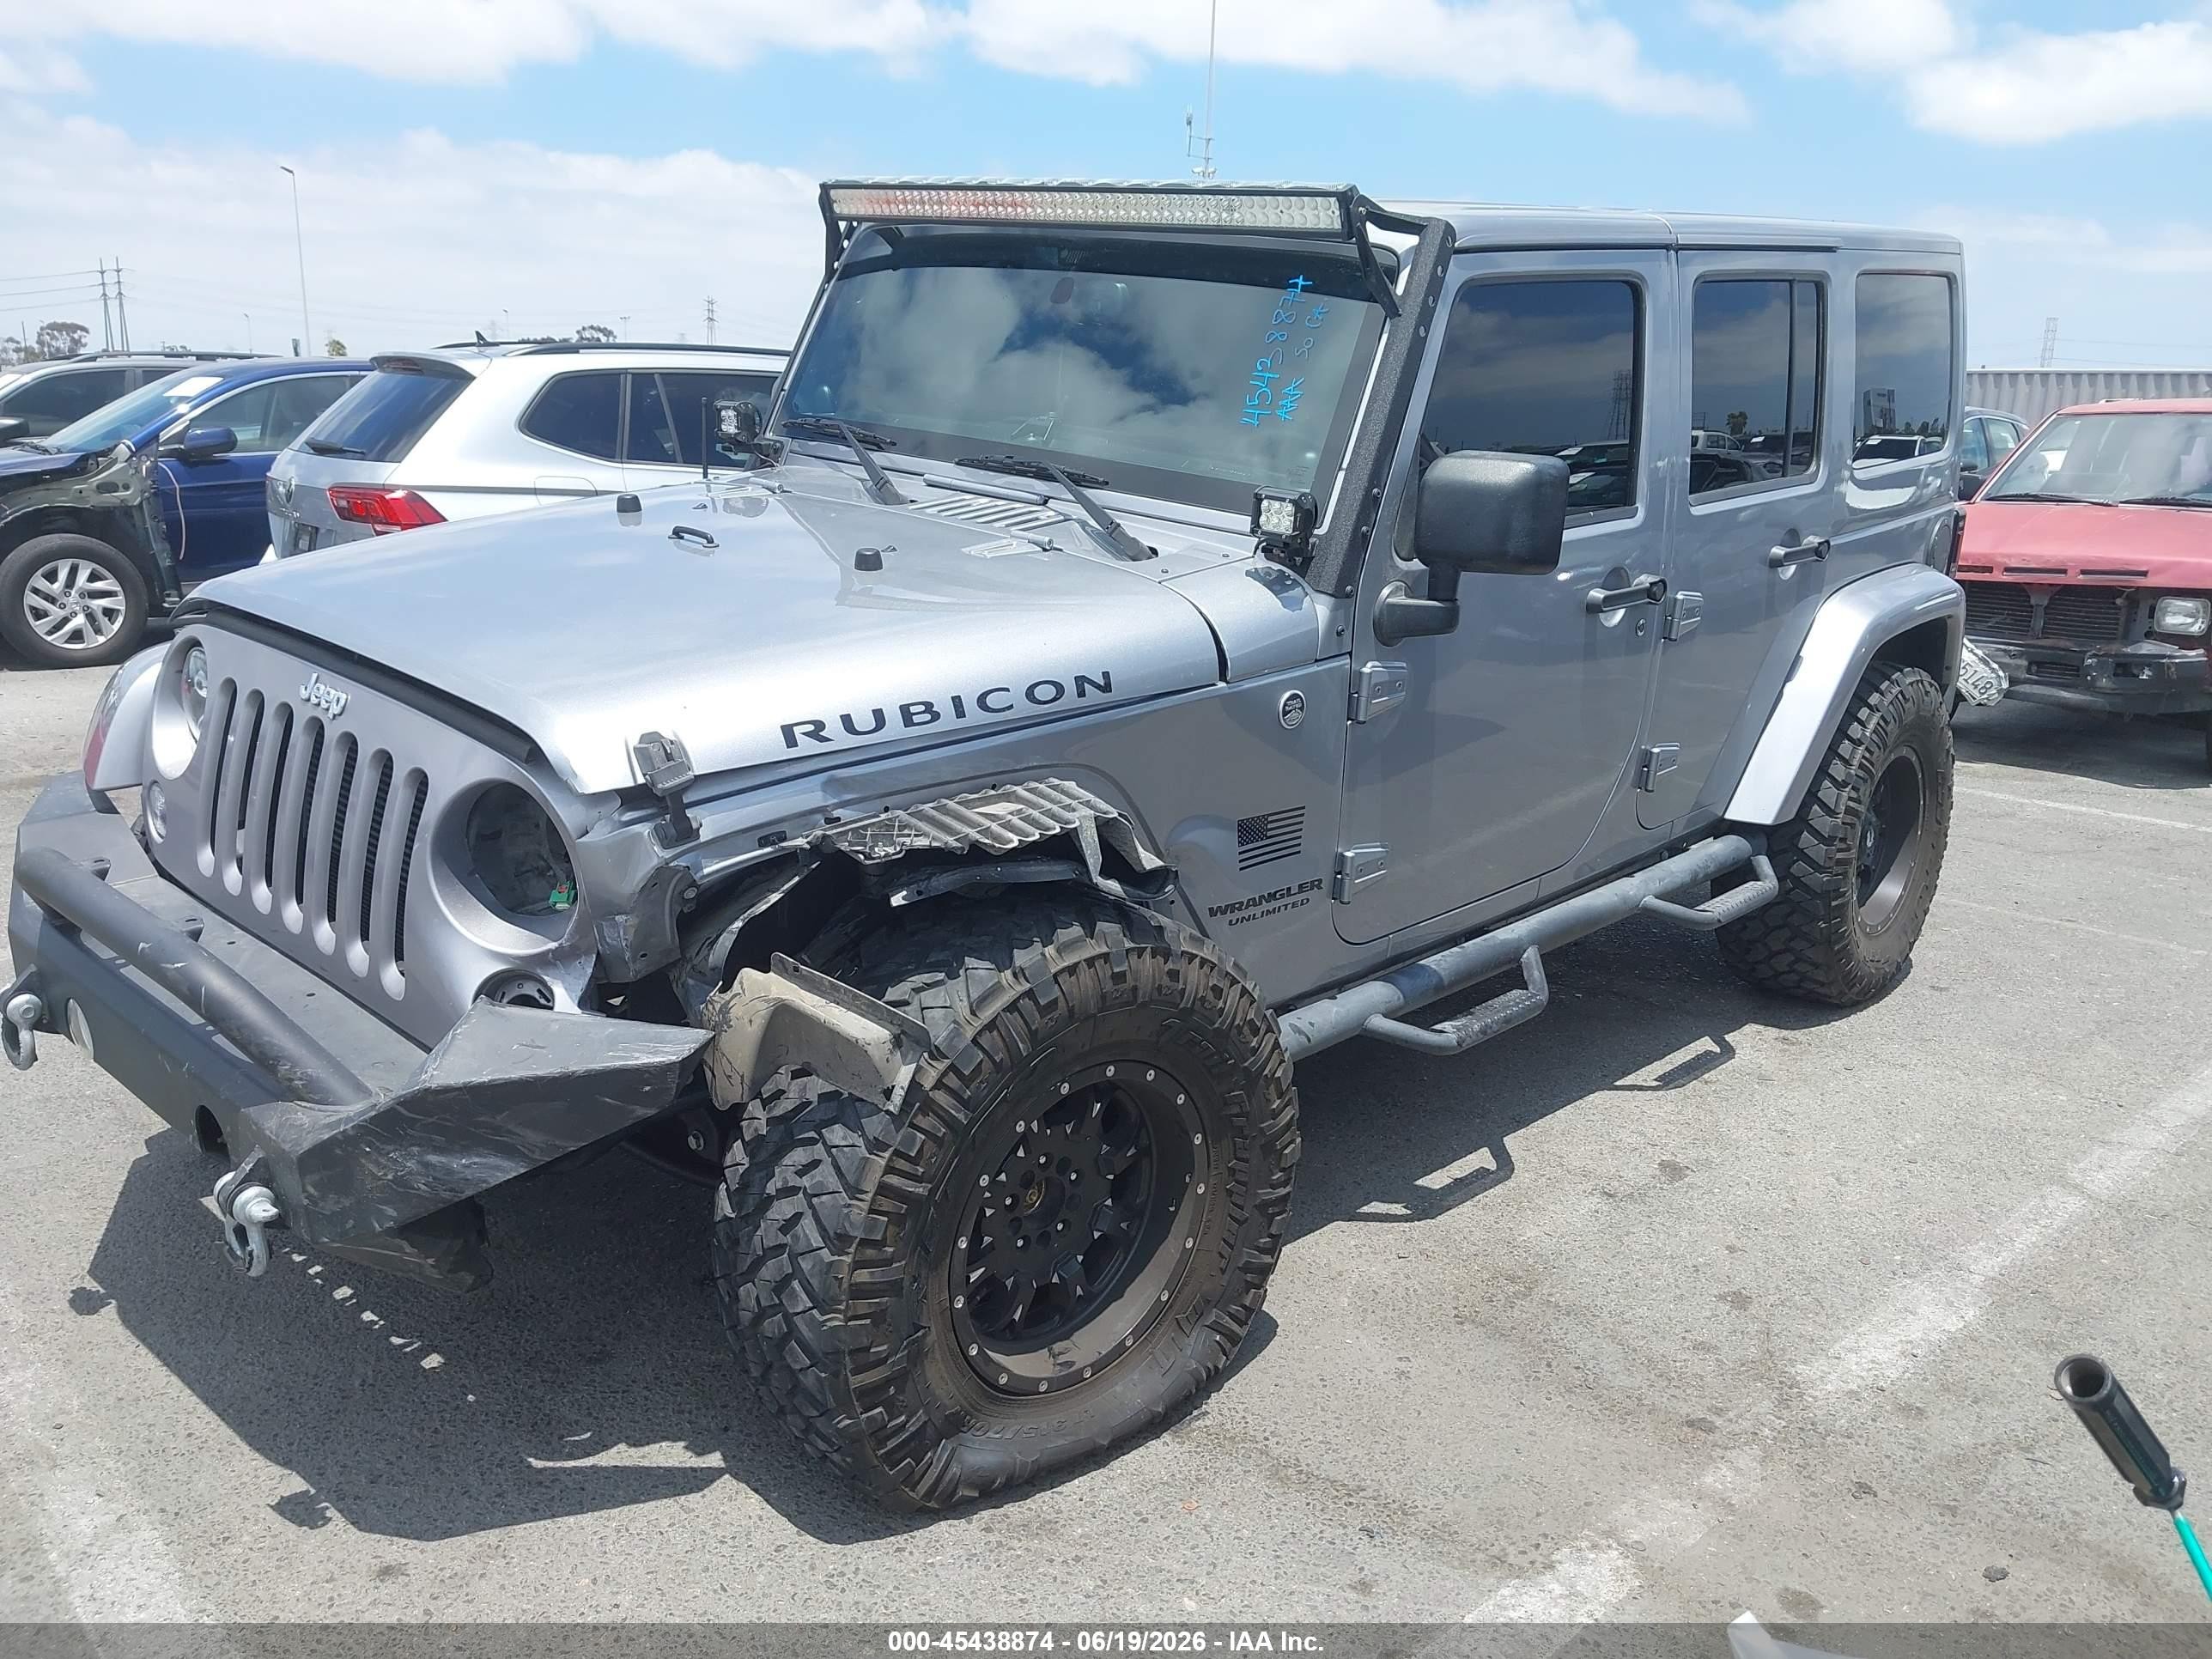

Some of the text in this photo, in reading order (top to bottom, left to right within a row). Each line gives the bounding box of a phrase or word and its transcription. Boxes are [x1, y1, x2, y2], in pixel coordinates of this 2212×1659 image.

[1239, 274, 1313, 427] 45438874
[299, 672, 348, 720] Jeep
[780, 671, 1113, 749] RUBICON
[1207, 878, 1323, 918] WRANGLER
[1228, 897, 1310, 927] UNLIMITED
